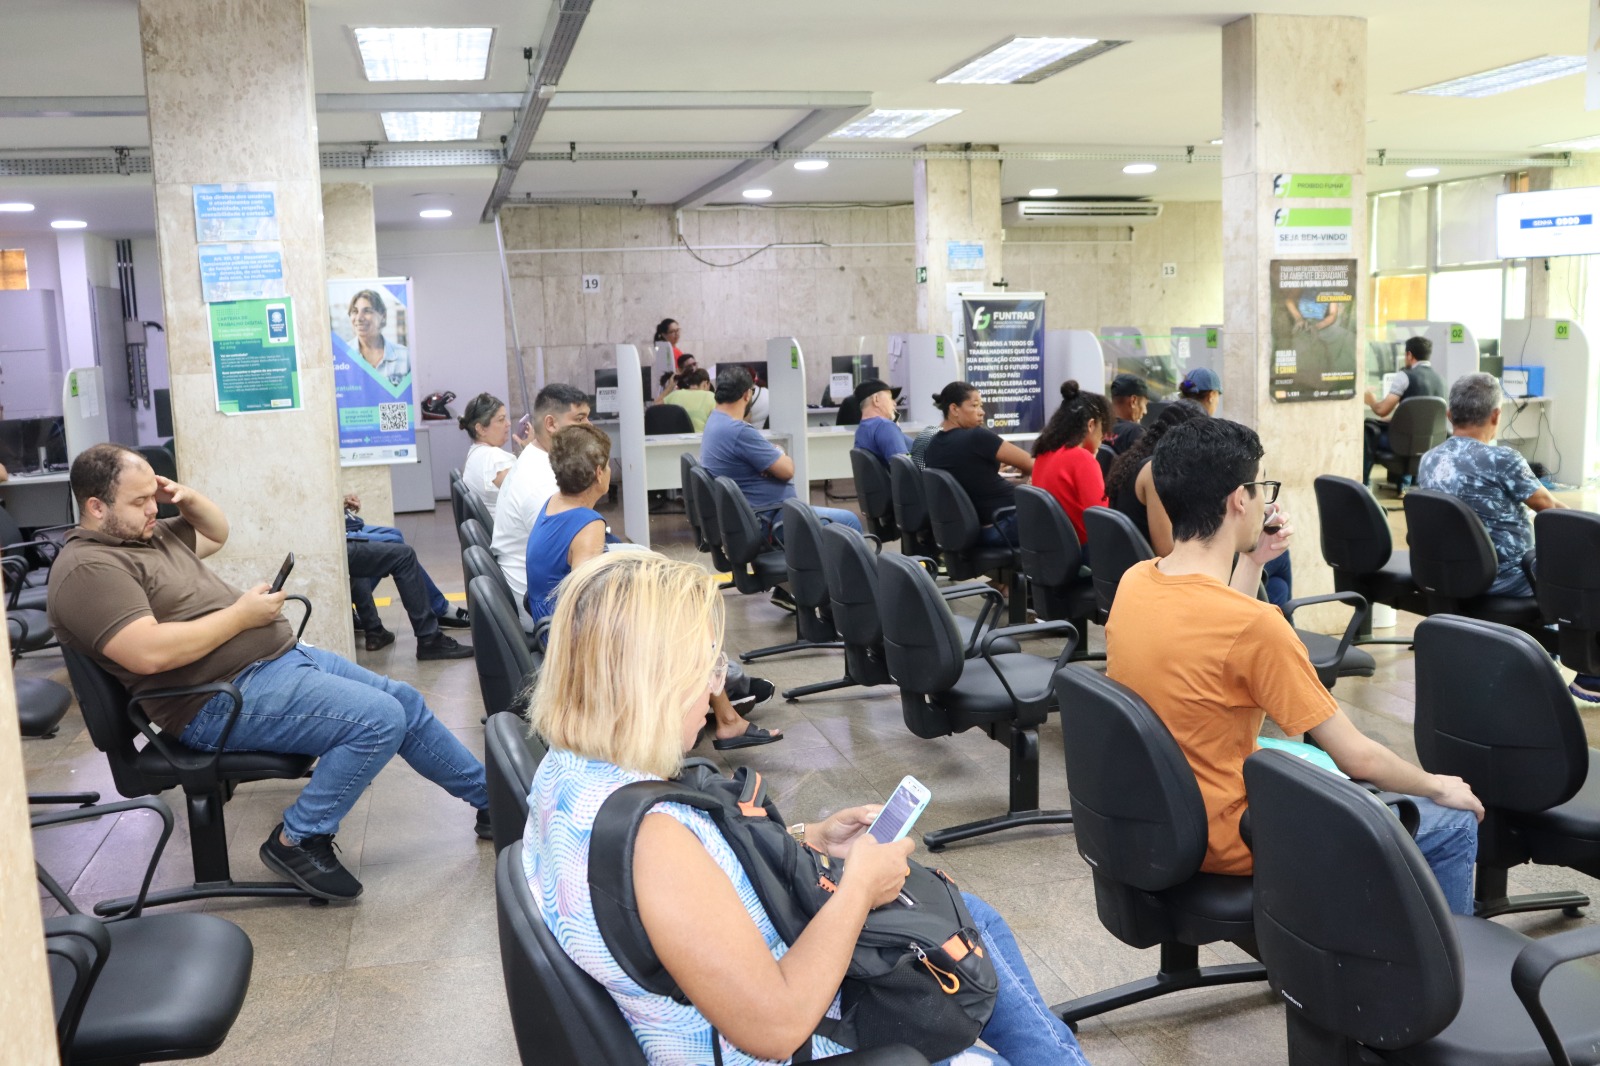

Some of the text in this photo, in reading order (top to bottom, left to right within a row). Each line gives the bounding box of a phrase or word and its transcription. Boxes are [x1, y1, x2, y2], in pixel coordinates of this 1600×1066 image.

[1164, 266, 1175, 275] 13
[1280, 272, 1288, 280] EM
[1289, 271, 1314, 280] AMBIENTE
[585, 279, 598, 289] 19
[993, 311, 1035, 320] FUNTRAB
[1452, 329, 1462, 338] 02
[1557, 325, 1567, 334] 01
